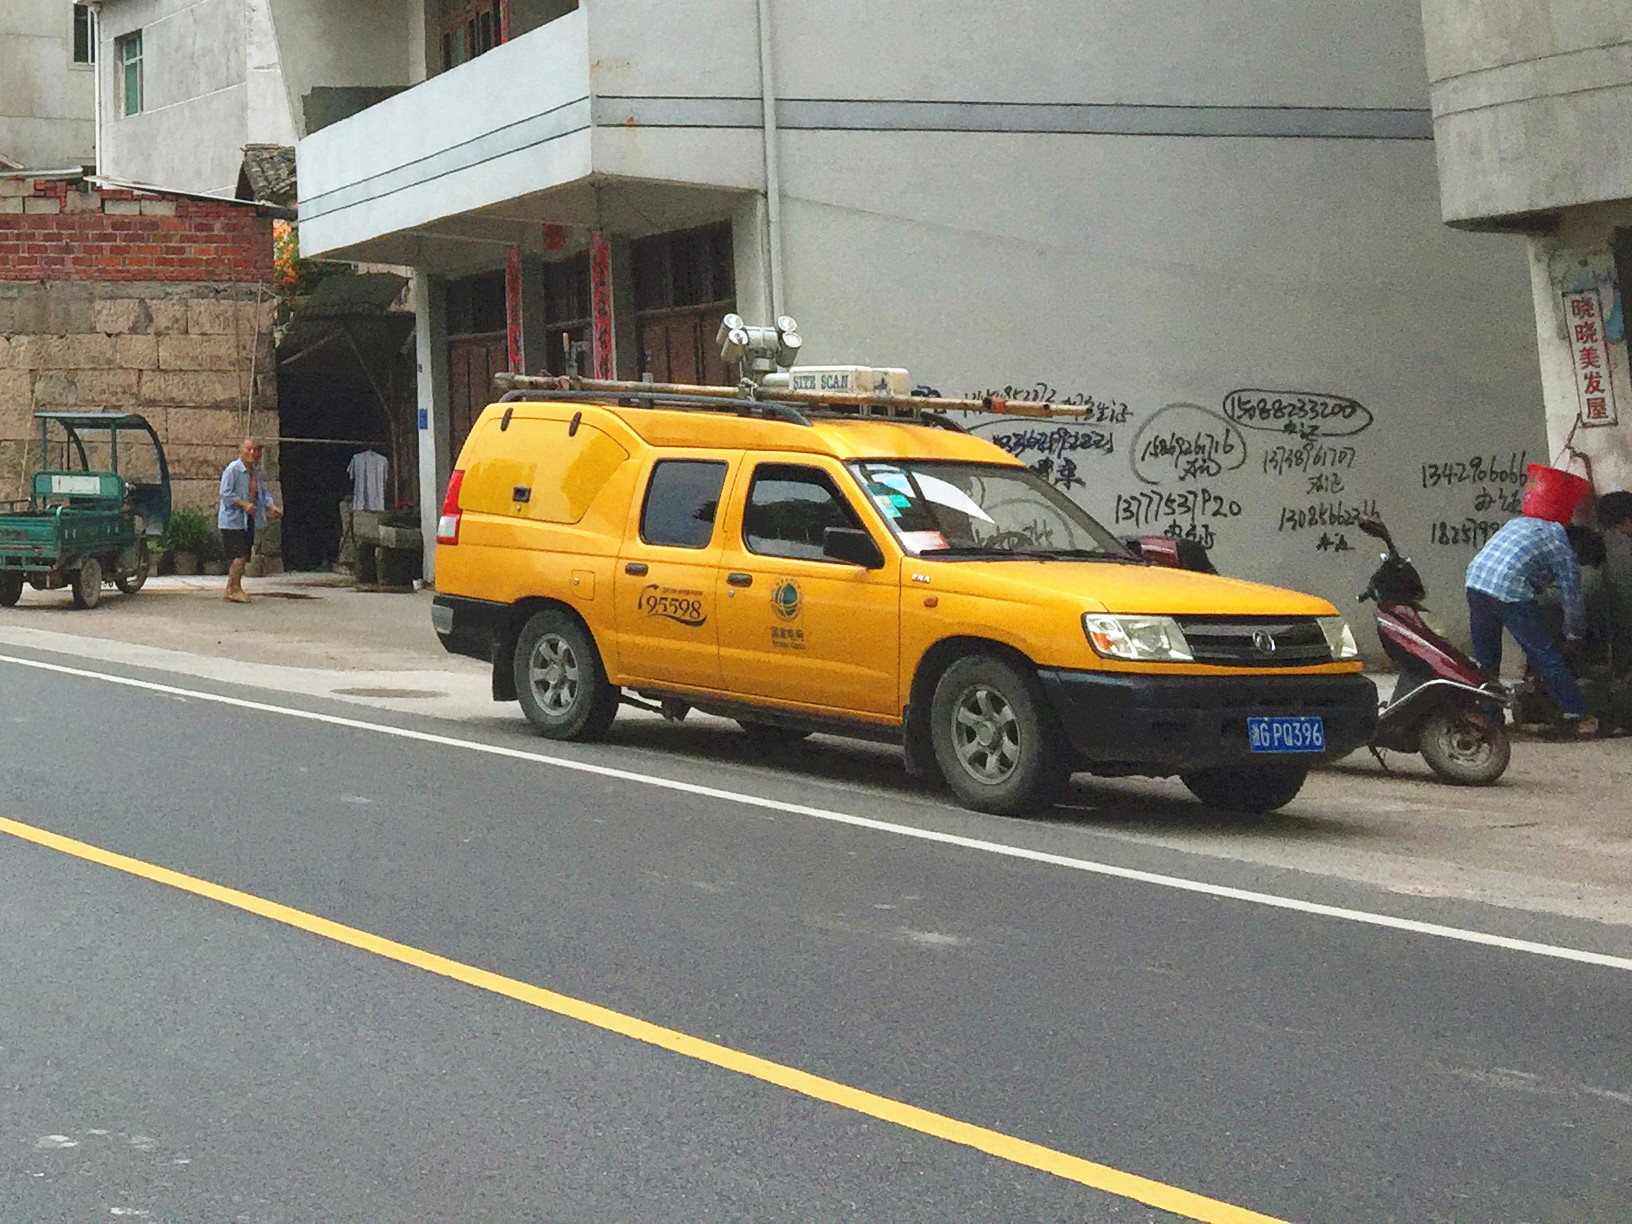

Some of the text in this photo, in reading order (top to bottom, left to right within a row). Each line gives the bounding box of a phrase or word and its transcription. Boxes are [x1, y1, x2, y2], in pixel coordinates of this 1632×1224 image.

[1571, 296, 1609, 420] 晓晓美发屋
[793, 375, 849, 389] SITE SCAN
[646, 594, 703, 620] 95598
